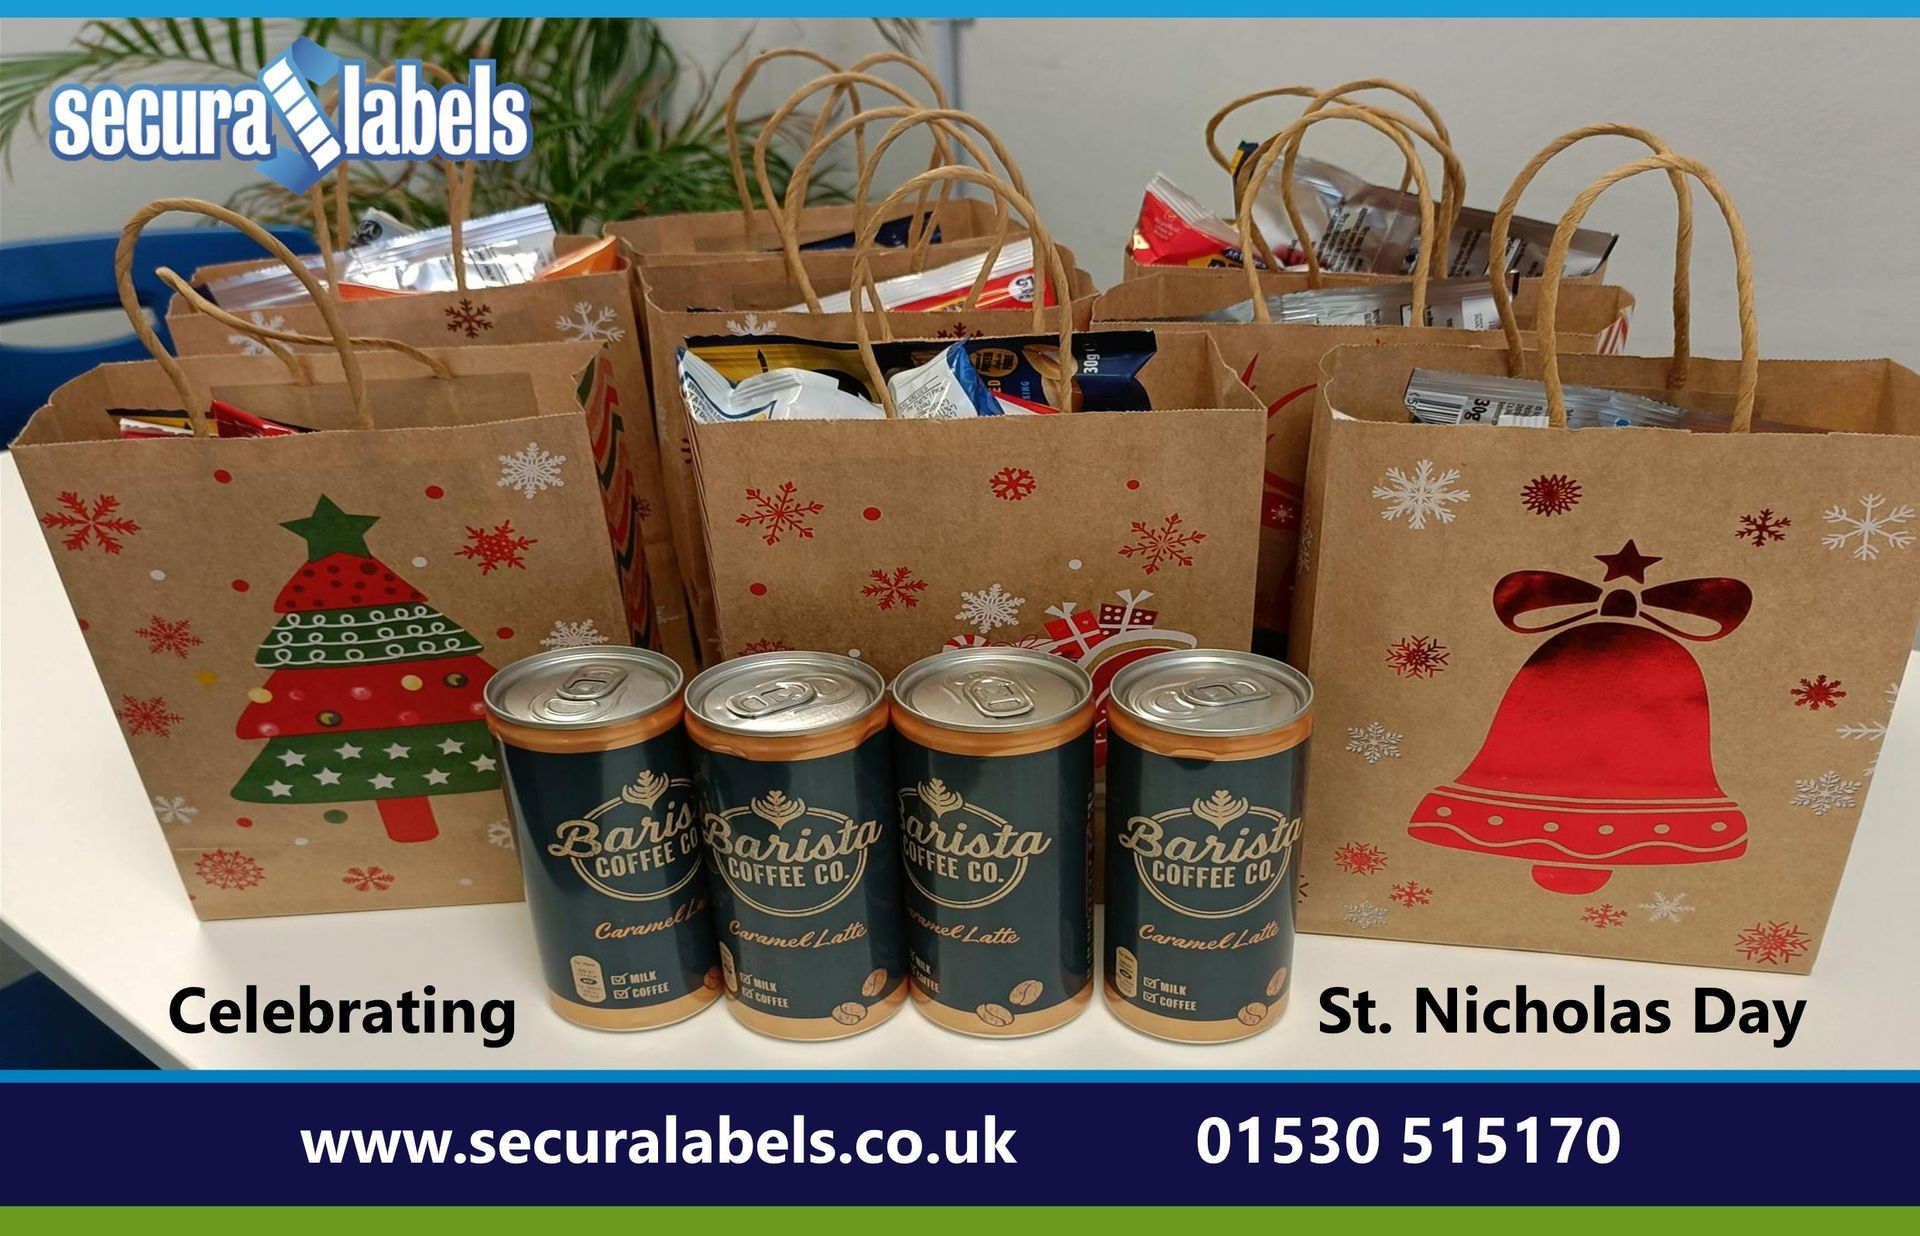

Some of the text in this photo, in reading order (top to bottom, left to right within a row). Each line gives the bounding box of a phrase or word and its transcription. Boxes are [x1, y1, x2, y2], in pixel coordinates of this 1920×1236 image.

[1083, 353, 1100, 374] 30g
[1464, 398, 1491, 422] 30g
[703, 813, 883, 864] Barista
[1118, 816, 1303, 865] Barista
[595, 841, 676, 878] COFFEE
[728, 857, 850, 887] COFFEE CO.
[903, 834, 1004, 883] COFFEE CO.
[1152, 859, 1275, 889] COFFEE CO.
[594, 903, 687, 940] Caramel
[729, 919, 868, 949] Caramel Latte
[961, 925, 1022, 945] Latte
[1139, 920, 1280, 950] Caramel Latte
[629, 970, 657, 984] MILK
[632, 982, 670, 998] COFFEE
[753, 977, 777, 993] MILK
[1160, 981, 1187, 996] MILK
[755, 992, 790, 1008] COFFEE
[1159, 996, 1198, 1011] COFFEE
